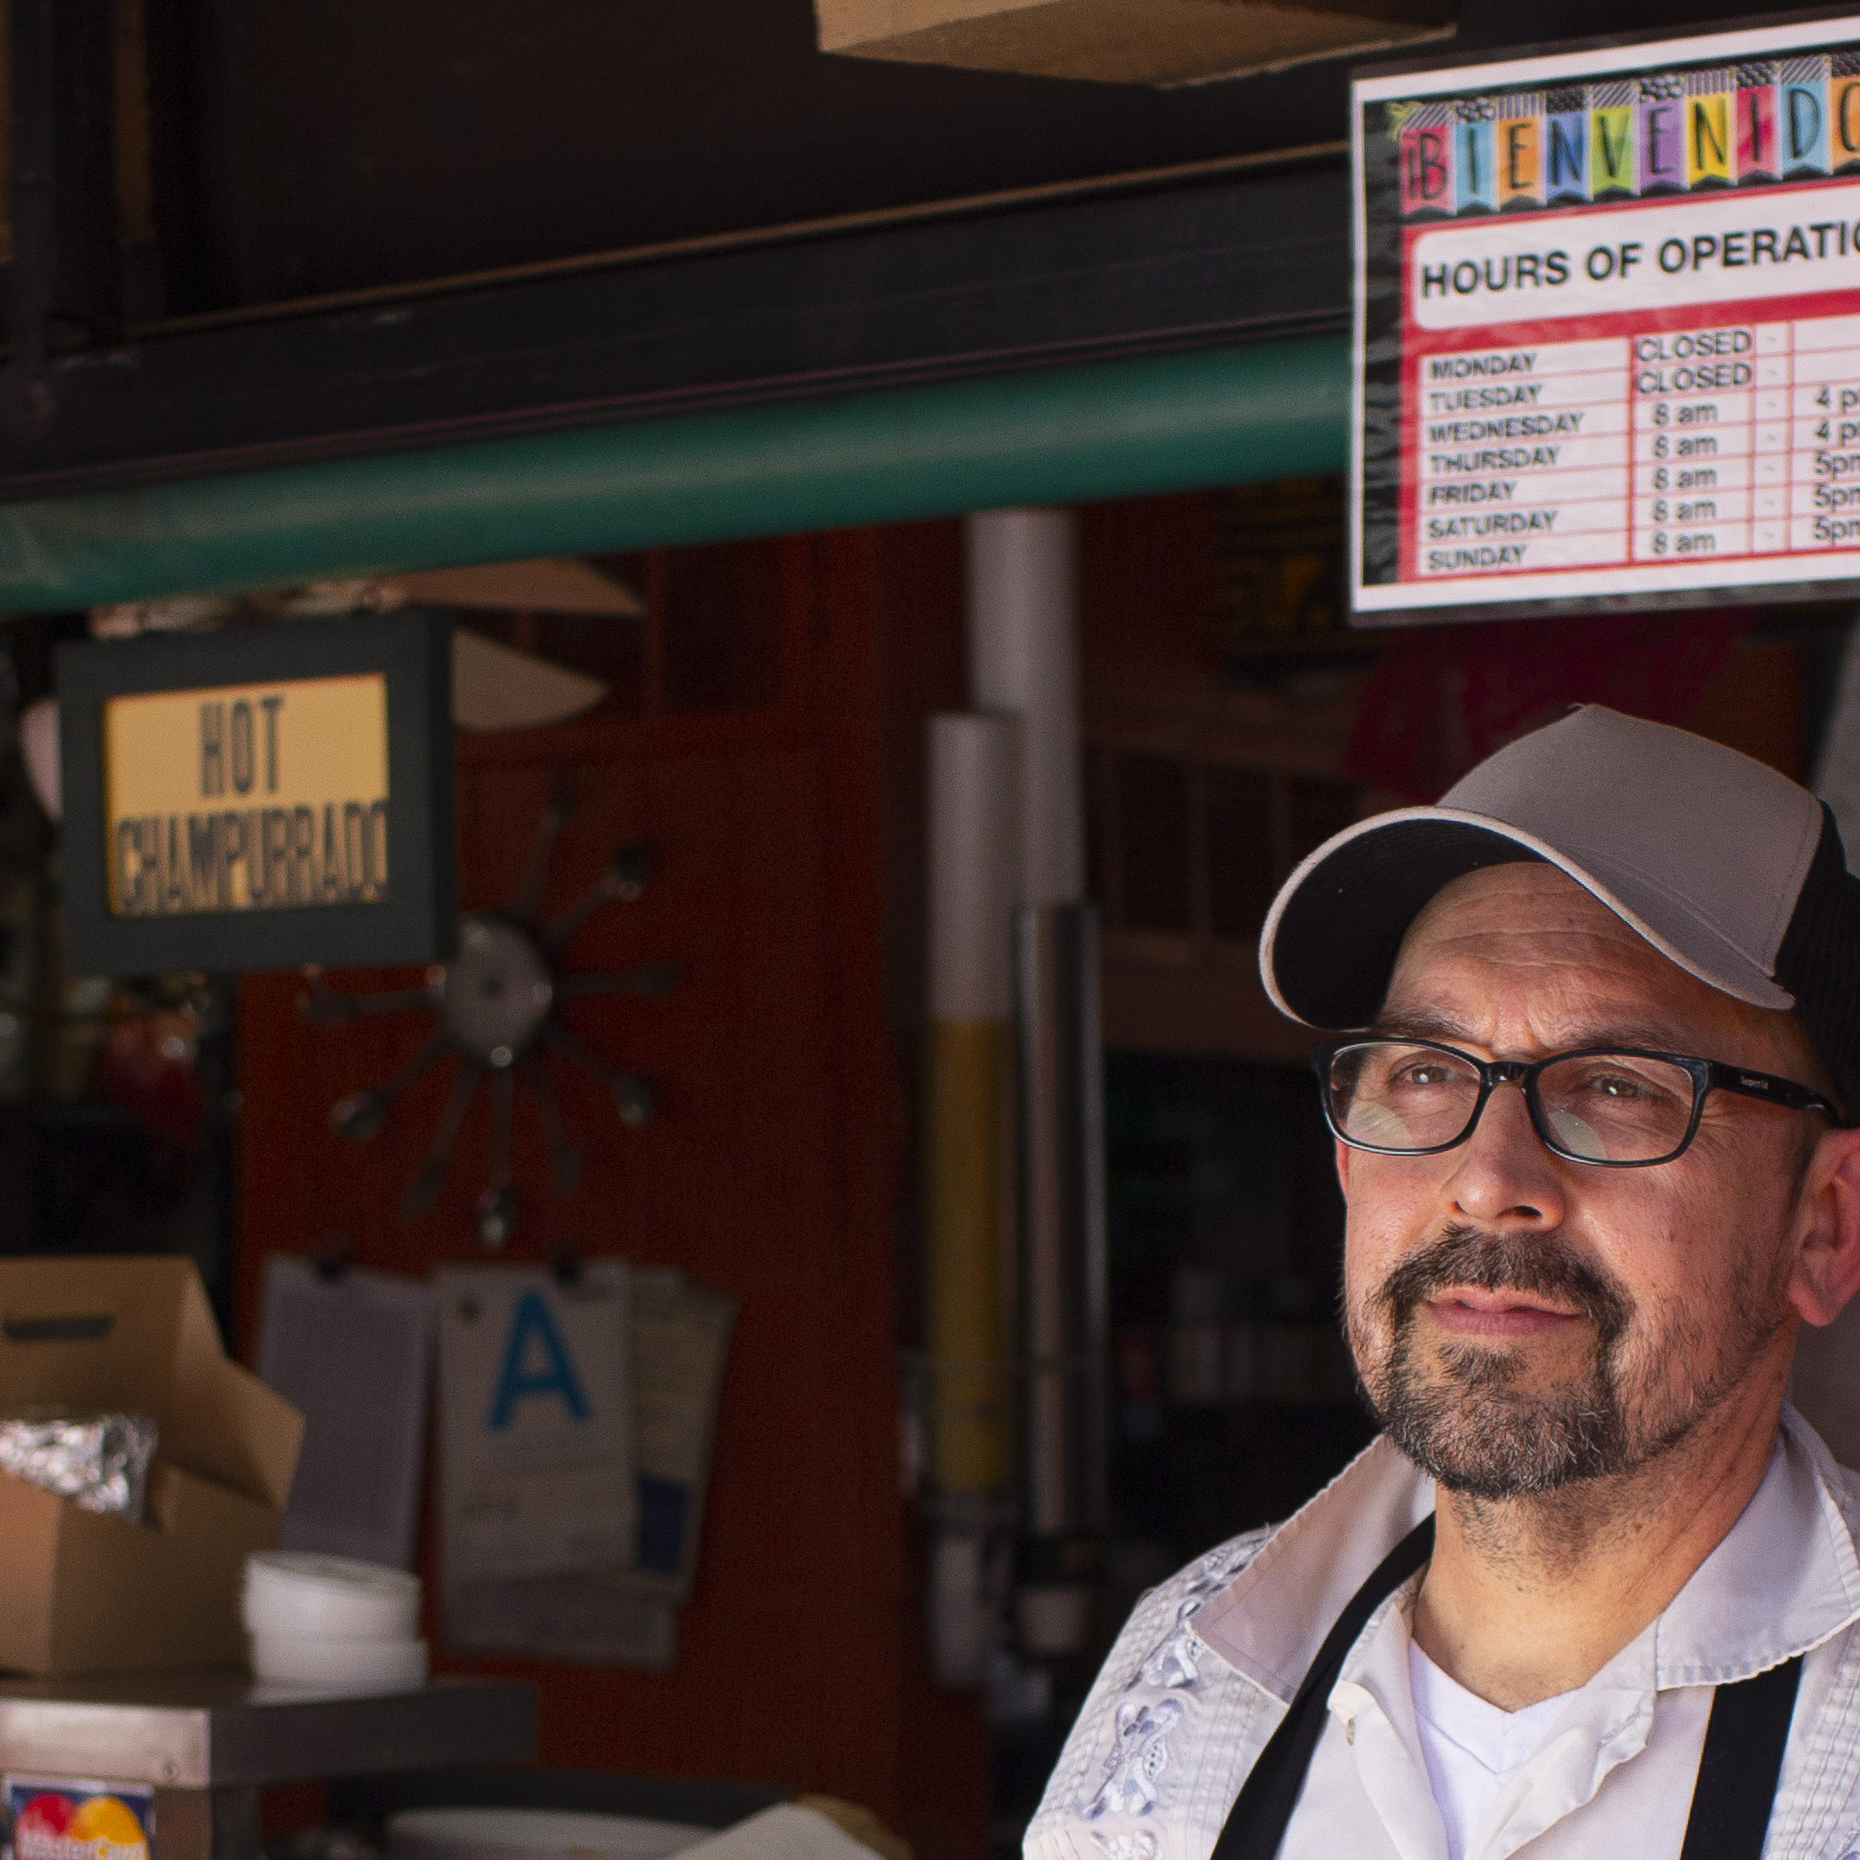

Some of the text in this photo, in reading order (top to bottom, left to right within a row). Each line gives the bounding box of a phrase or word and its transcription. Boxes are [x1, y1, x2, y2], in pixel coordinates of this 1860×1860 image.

[1422, 250, 1570, 298] HOURS
[1586, 243, 1641, 280] OF
[1429, 330, 1753, 381] MONDAY CLOSED
[1429, 363, 1753, 413] TUESDAY CLOSED
[1429, 413, 1584, 442] WEDNESDAY
[1652, 403, 1669, 425] 8
[1676, 406, 1717, 424] am
[1815, 386, 1832, 408] 4
[1428, 446, 1561, 473] THURSDAY
[1652, 436, 1669, 458] 8
[1676, 438, 1717, 457] am
[1815, 419, 1832, 441] 4
[1428, 480, 1516, 506] FRIDAY
[1652, 468, 1669, 490] 8
[1676, 470, 1717, 488] am
[1427, 511, 1558, 539] SATURDAY
[1652, 500, 1669, 522] 8
[1676, 502, 1717, 521] am
[1427, 545, 1527, 571] SUNDAY
[1652, 533, 1669, 554] 8
[1676, 535, 1717, 552] am
[200, 694, 284, 798] HOT
[487, 1290, 592, 1431] A
